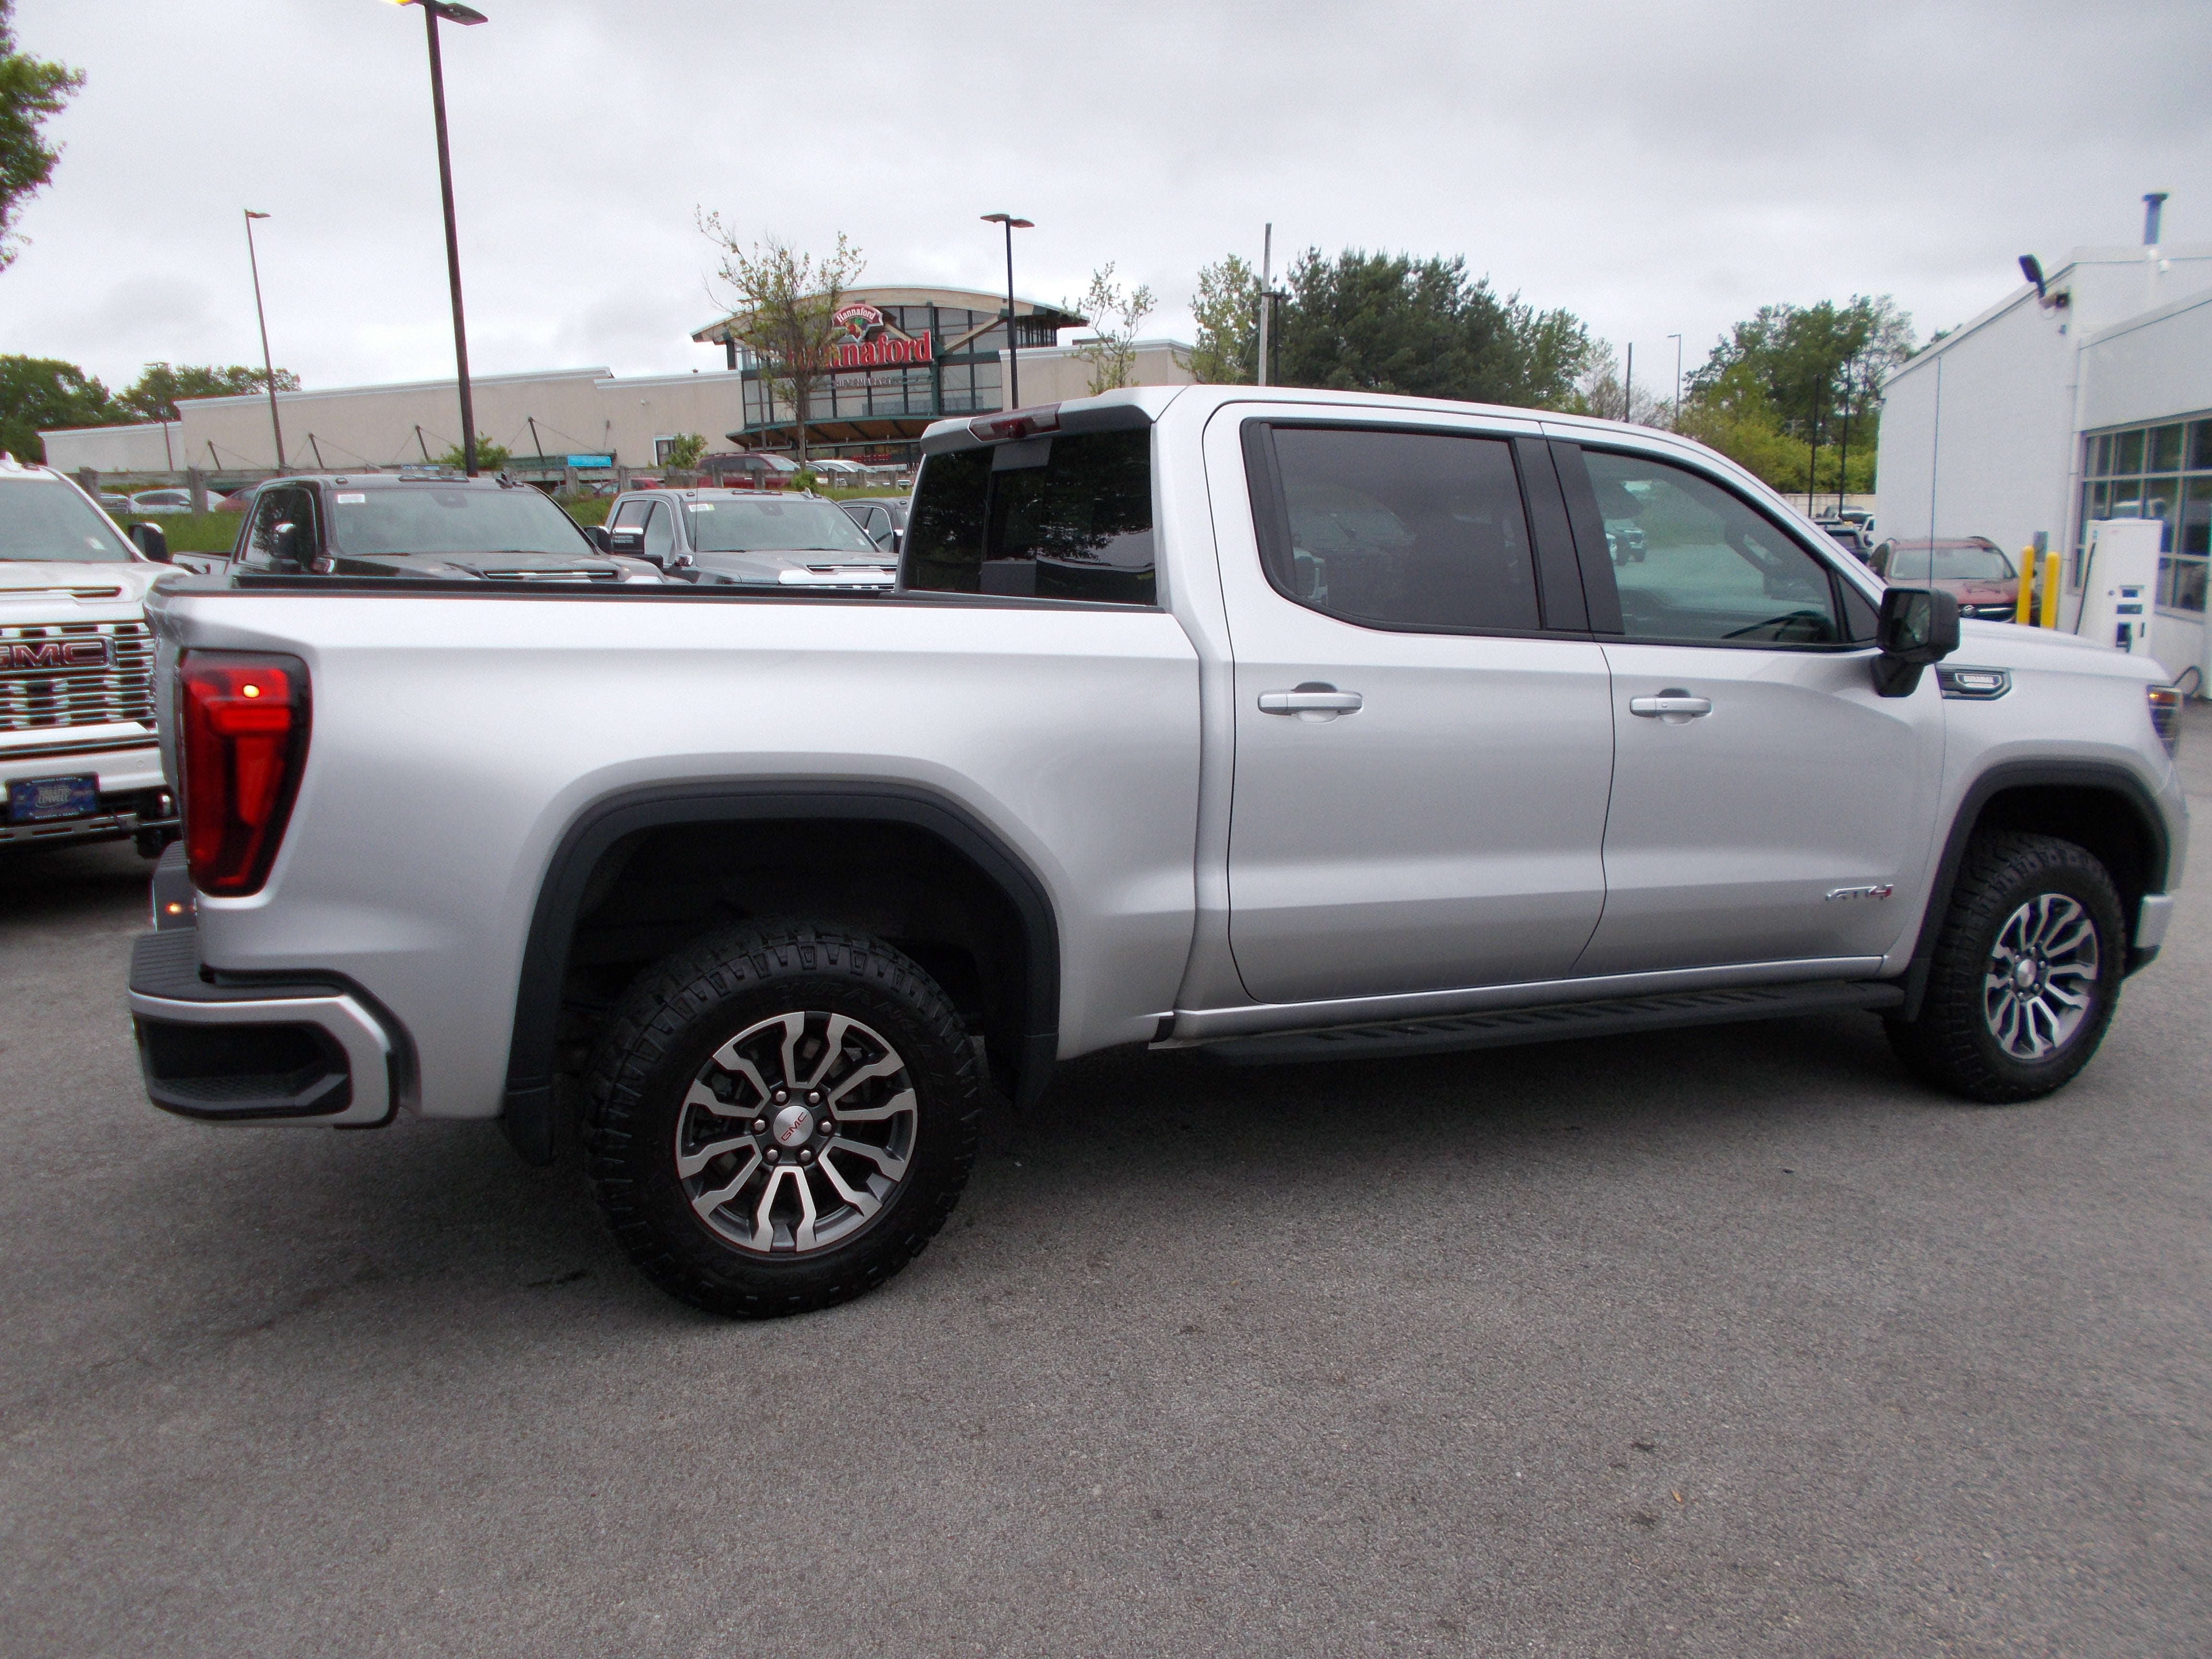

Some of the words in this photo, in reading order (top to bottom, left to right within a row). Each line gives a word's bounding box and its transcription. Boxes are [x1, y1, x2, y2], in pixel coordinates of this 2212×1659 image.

[836, 307, 877, 323] Hannaford
[0, 641, 104, 668] MC
[781, 1111, 807, 1142] GMC
